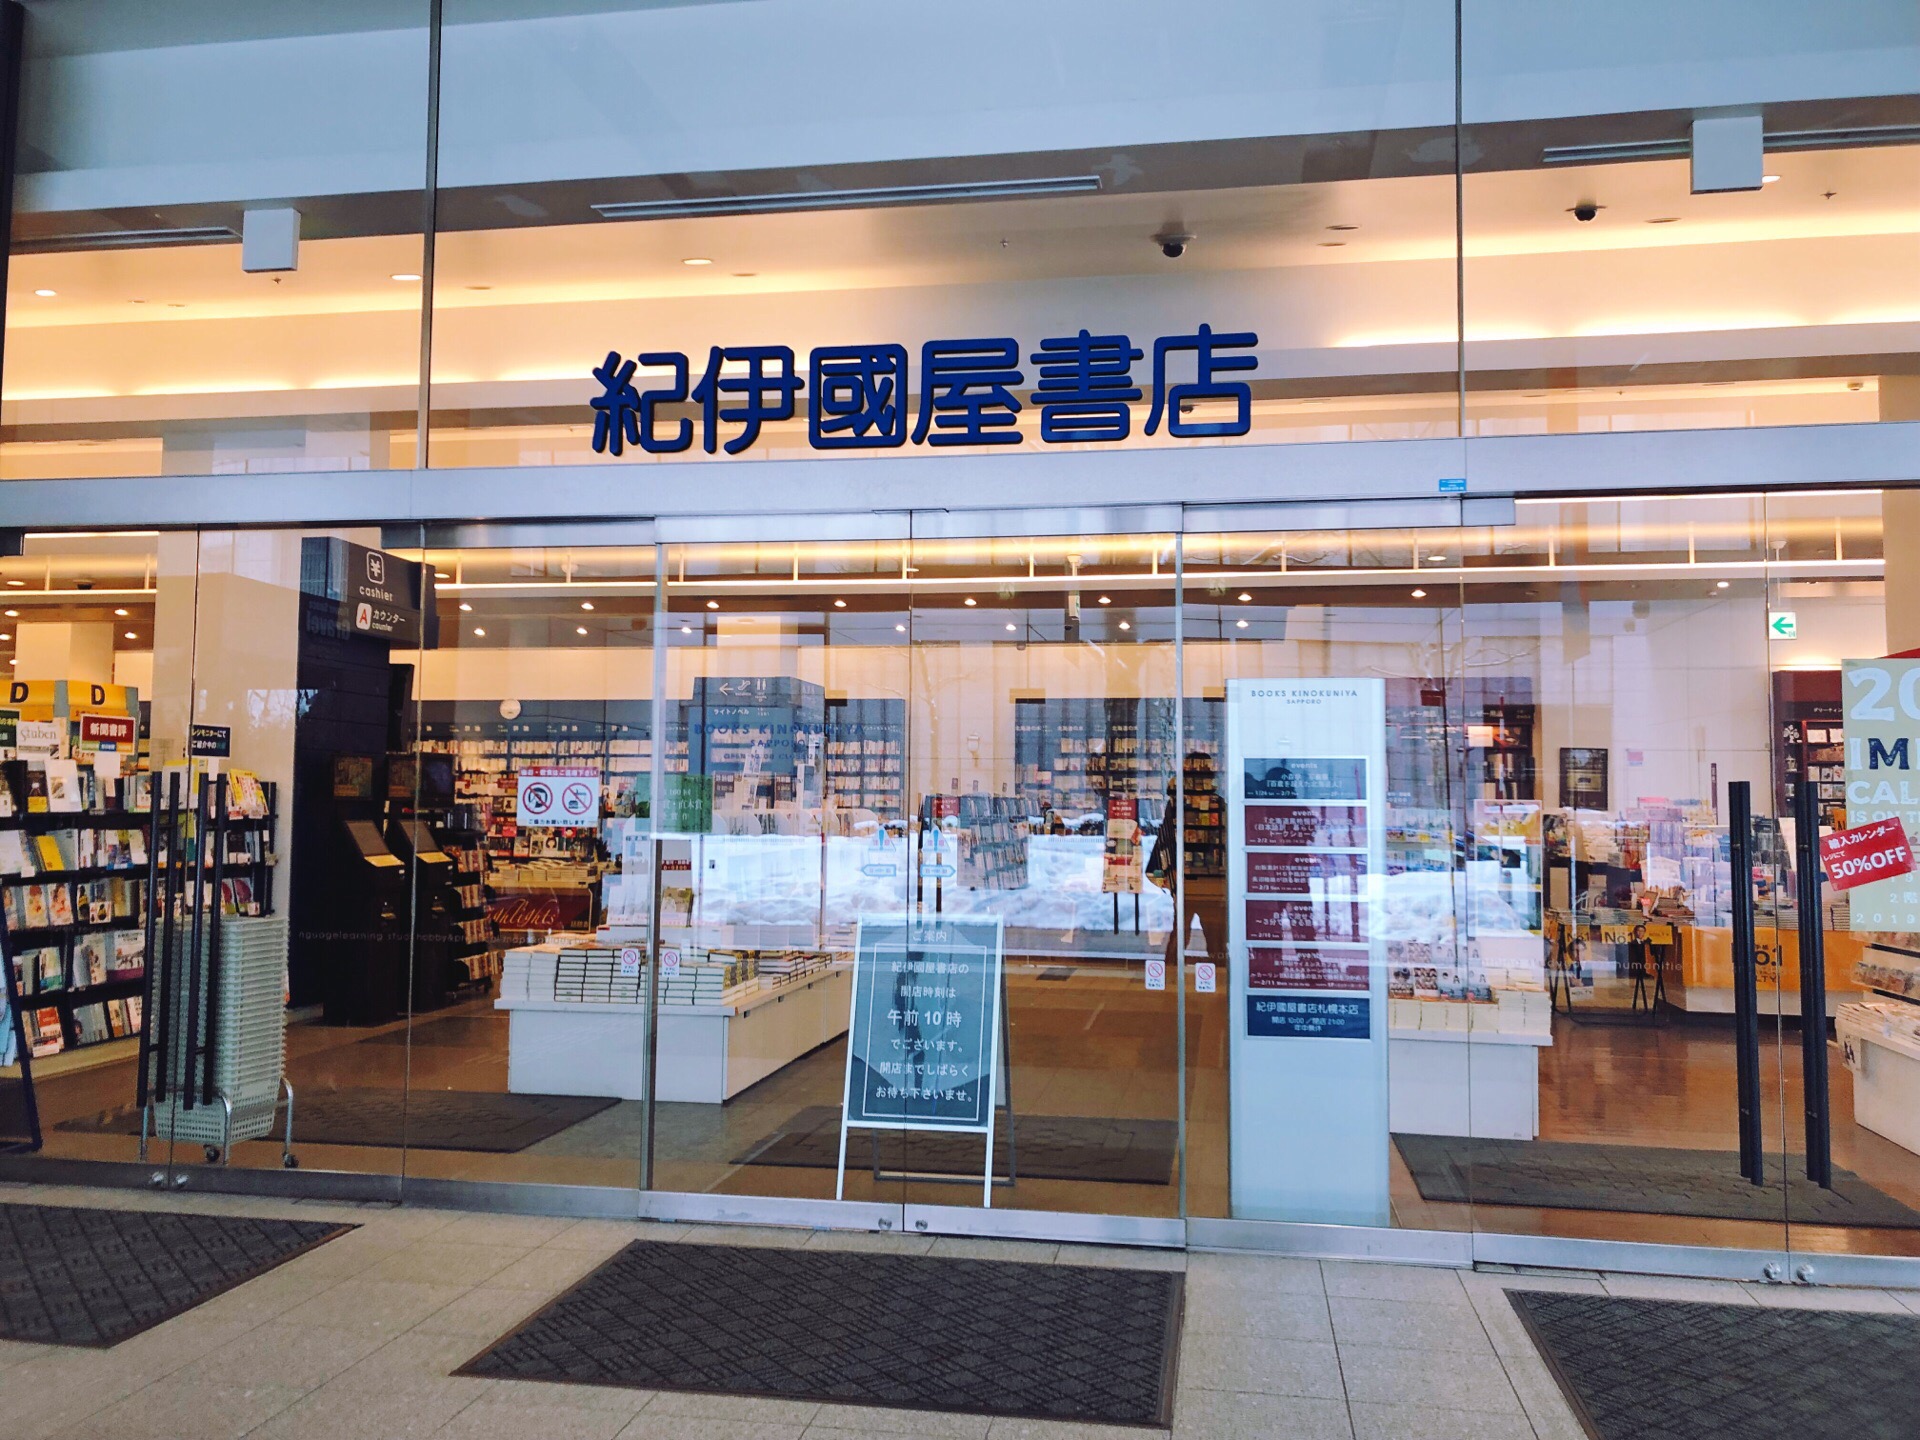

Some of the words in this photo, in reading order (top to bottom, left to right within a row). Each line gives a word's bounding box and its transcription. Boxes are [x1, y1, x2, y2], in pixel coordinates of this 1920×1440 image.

[589, 322, 1258, 457] 紀伊國屋書店
[359, 585, 394, 602] cashier
[359, 609, 368, 625] A
[373, 609, 406, 624] カウンター
[372, 622, 393, 632] counter
[10, 682, 29, 703] D
[91, 684, 105, 706] D
[713, 708, 749, 716] ライトノベル
[90, 722, 127, 737] 新聞書評
[693, 723, 750, 735] BOOKS
[759, 723, 867, 735] KINOKUNIYA
[1849, 737, 1920, 771] IM
[1850, 810, 1868, 823] IS
[1828, 825, 1896, 850] 輸入カレンダー
[1823, 851, 1846, 862] レジにて
[1831, 845, 1907, 880] 50%OFF
[912, 930, 948, 942] ご案内
[891, 961, 970, 974] 紀伊國屋書店の
[900, 985, 956, 999] 開店時刻は
[1256, 1001, 1359, 1015] 紀伊國屋書店札幌本店
[891, 1038, 964, 1052] でございます。
[879, 1062, 969, 1077] 開店までしばらく
[876, 1086, 973, 1103] お待ち下さいませ。
